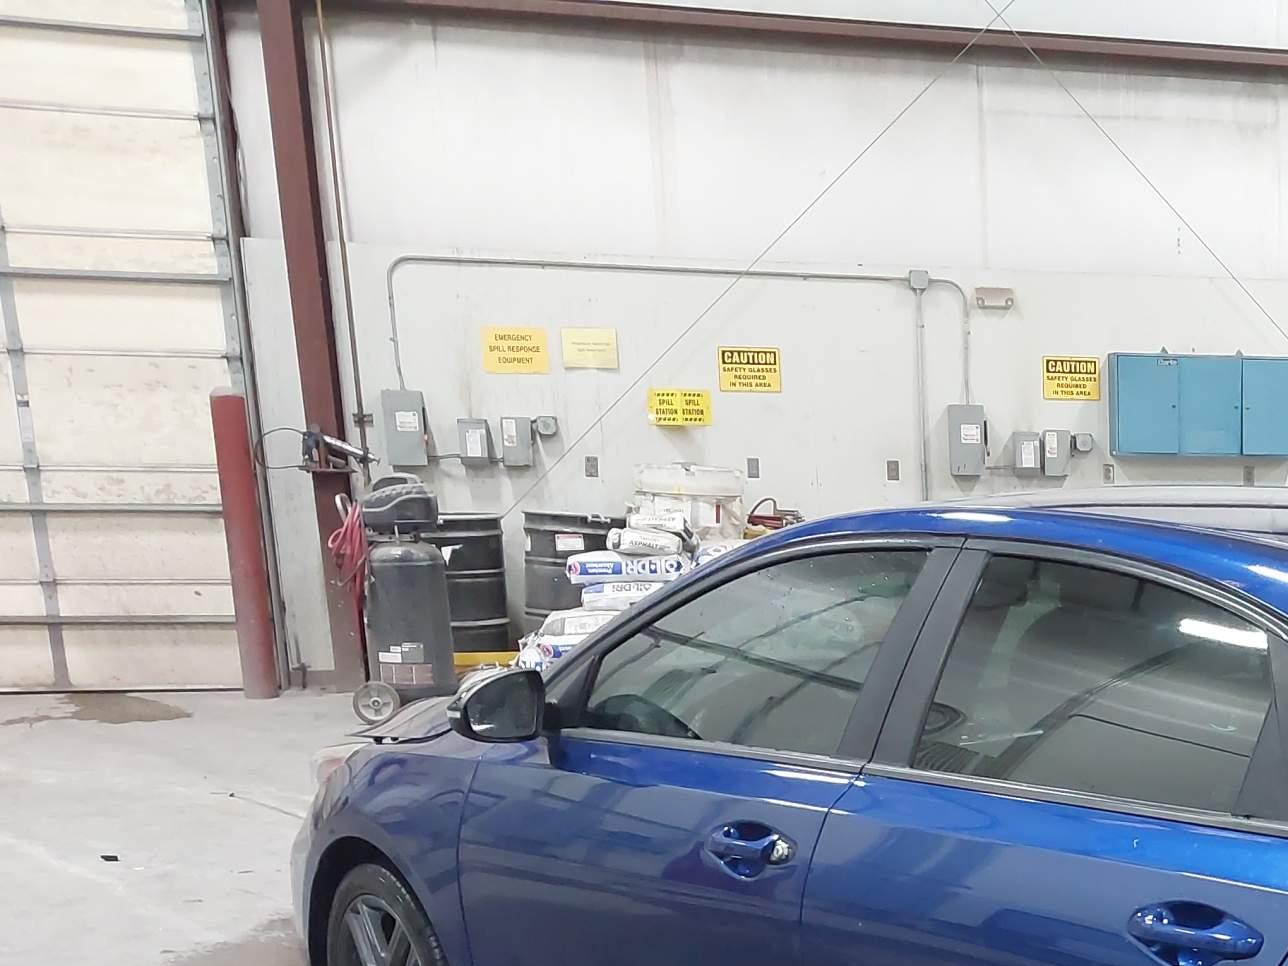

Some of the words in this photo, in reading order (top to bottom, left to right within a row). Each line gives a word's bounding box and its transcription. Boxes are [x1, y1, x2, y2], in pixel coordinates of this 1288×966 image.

[494, 333, 533, 342] EMERGENCY
[488, 345, 506, 353] SPILL
[507, 345, 541, 353] RESPONSE
[497, 356, 534, 365] EQUIPMENT
[724, 351, 775, 364] CAUTION
[1048, 360, 1095, 373] CAUTION
[658, 398, 675, 406] SPILL
[682, 408, 705, 416] STATION
